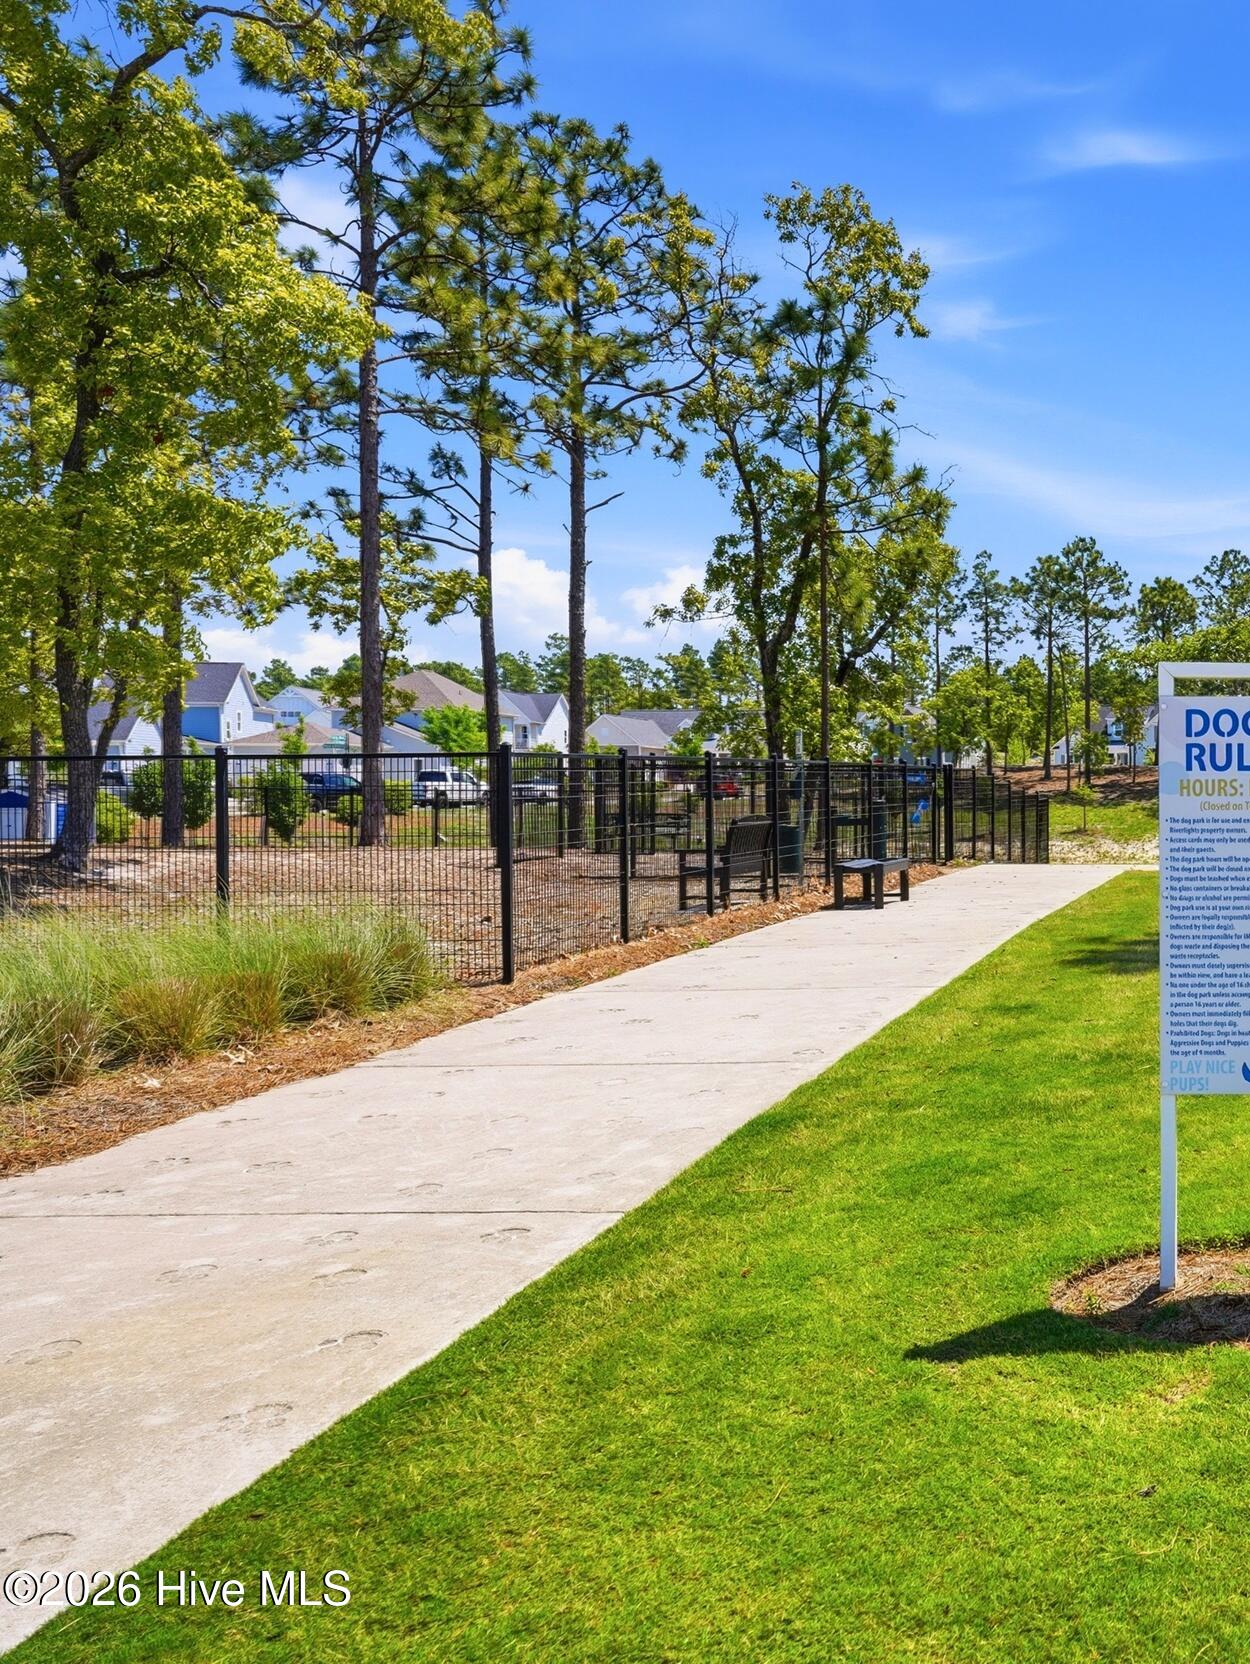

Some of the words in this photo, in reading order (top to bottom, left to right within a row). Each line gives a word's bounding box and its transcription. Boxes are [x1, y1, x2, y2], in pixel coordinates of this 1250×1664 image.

[1179, 778, 1244, 797] HOURS:
[1199, 801, 1231, 813] (Closed
[1232, 803, 1243, 811] on
[1170, 1060, 1201, 1074] PLAY
[1206, 1060, 1236, 1074] NICE
[1170, 1077, 1209, 1091] PUPS!
